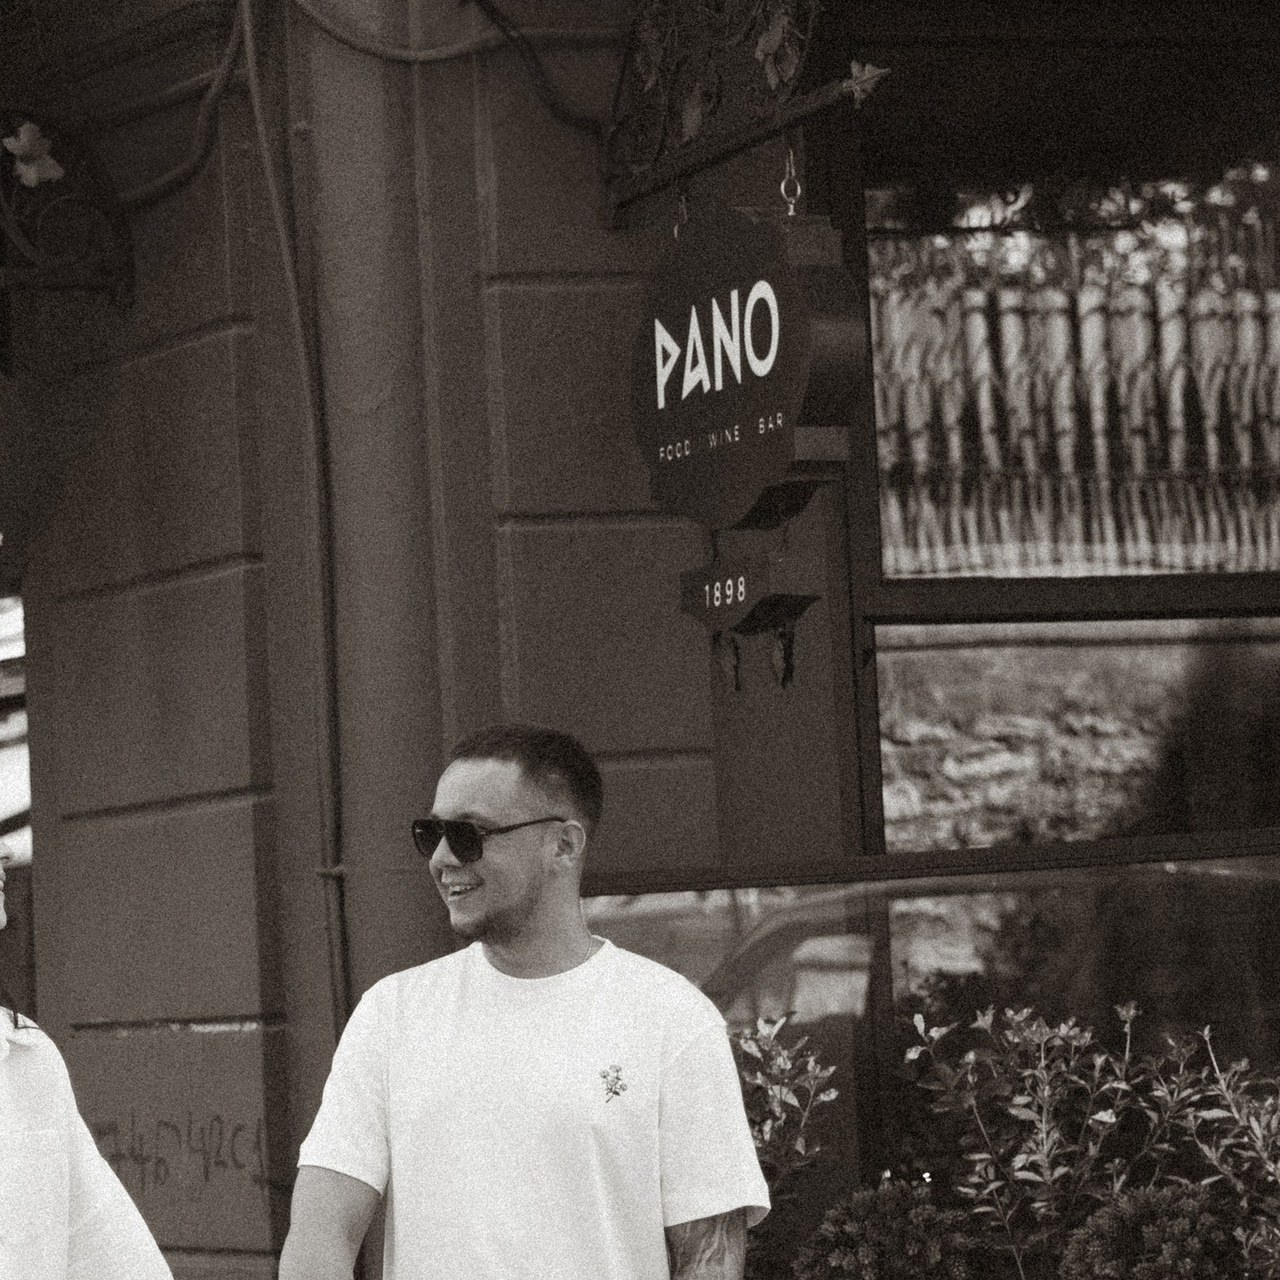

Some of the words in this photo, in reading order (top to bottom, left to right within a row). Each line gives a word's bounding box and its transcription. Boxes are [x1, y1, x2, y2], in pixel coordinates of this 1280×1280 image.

[654, 280, 780, 409] PANO
[658, 438, 691, 462] FOOD
[708, 424, 741, 449] WINE
[757, 412, 785, 436] BAR
[704, 576, 747, 608] 1898
